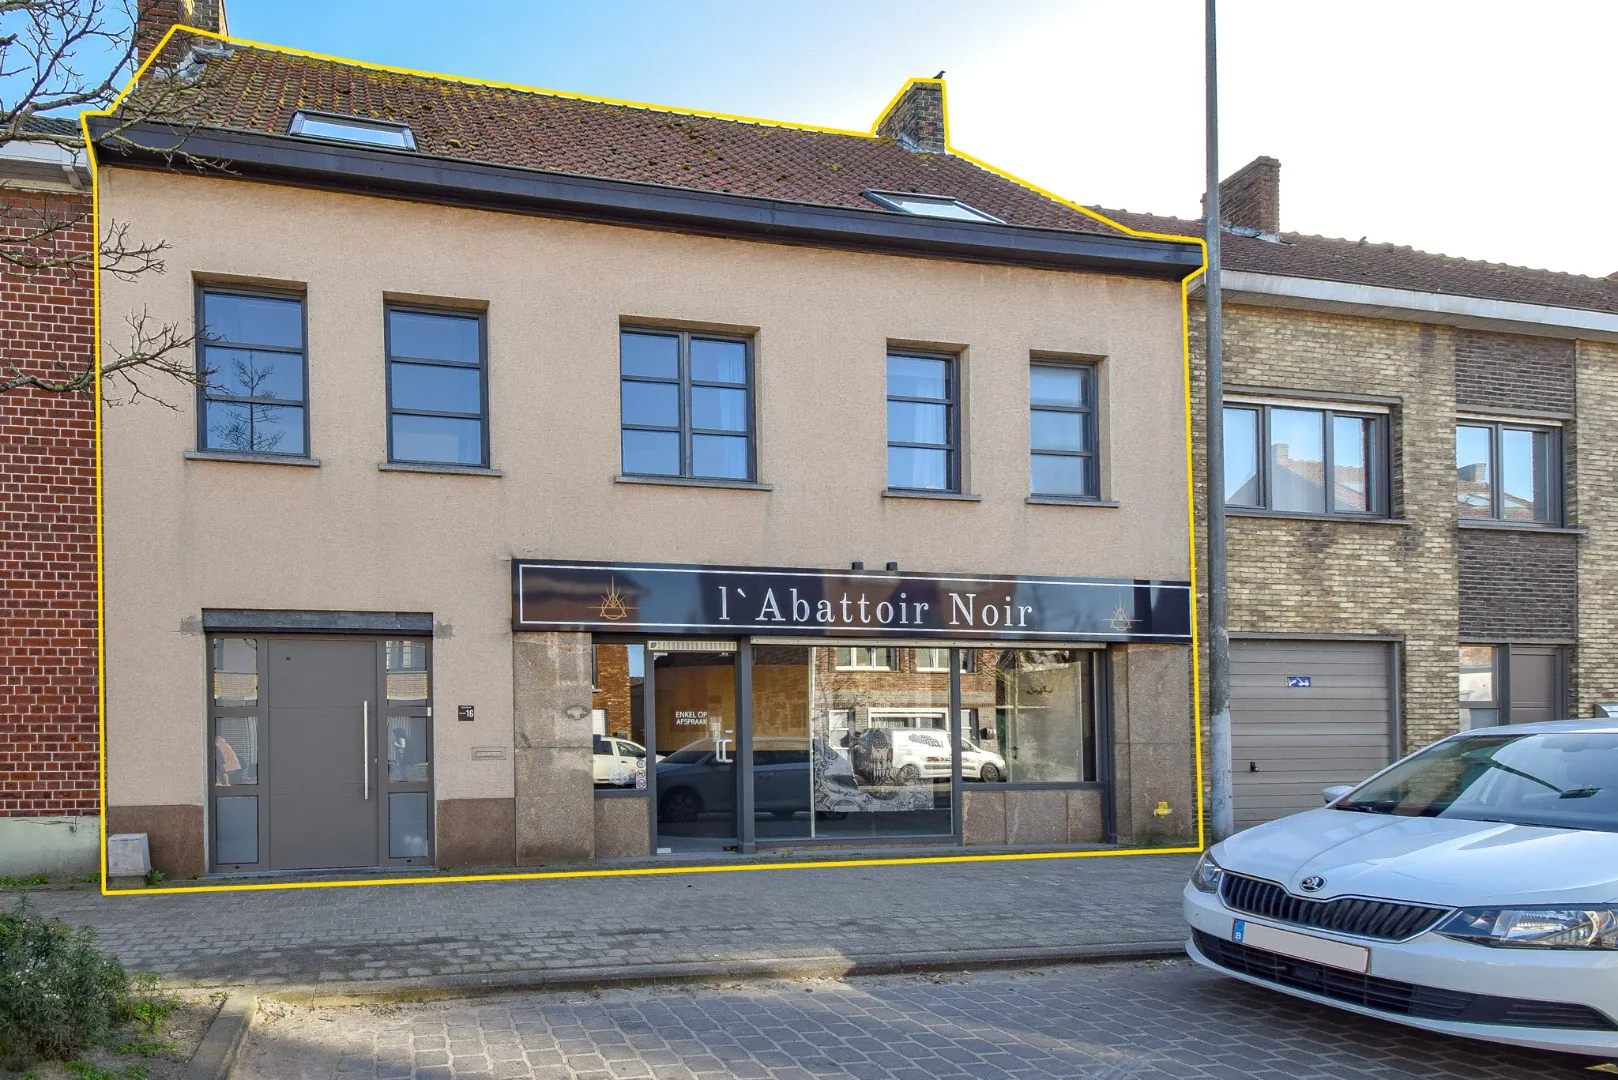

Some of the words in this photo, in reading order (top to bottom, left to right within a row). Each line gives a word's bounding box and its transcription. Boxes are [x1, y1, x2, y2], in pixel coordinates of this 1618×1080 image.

[949, 593, 1033, 627] Noir
[465, 709, 474, 718] 16
[1235, 931, 1242, 940] B
